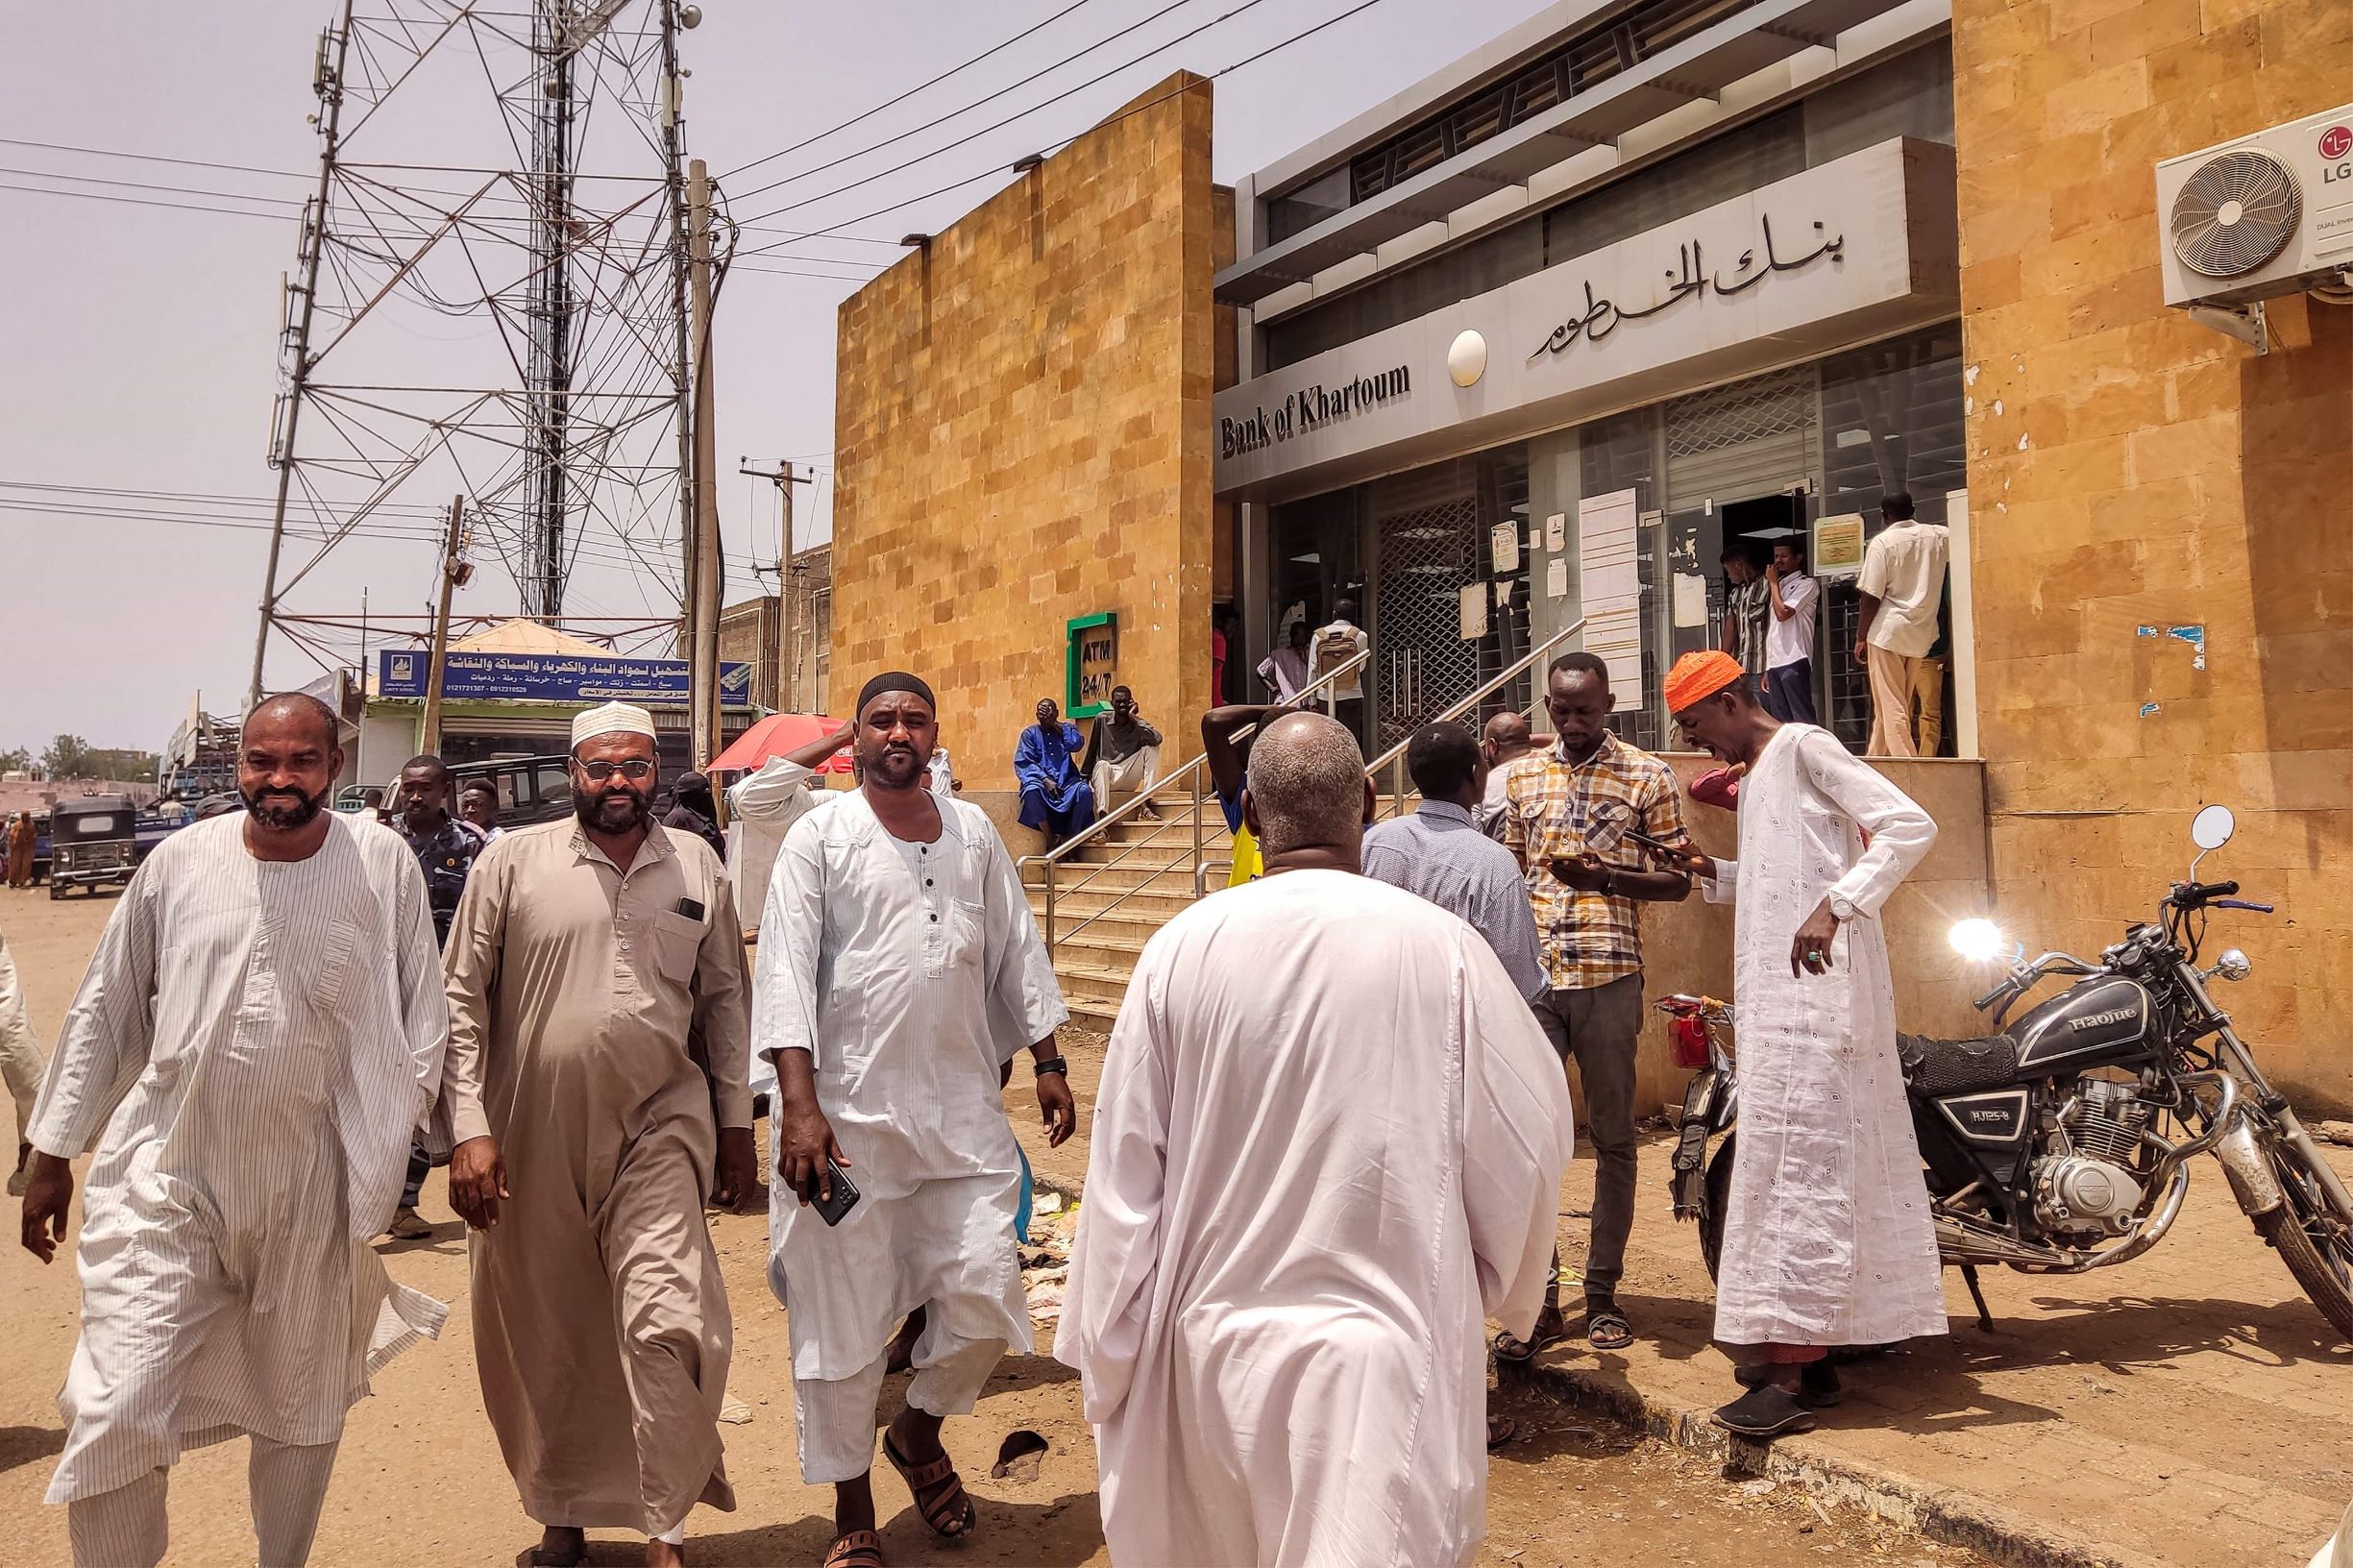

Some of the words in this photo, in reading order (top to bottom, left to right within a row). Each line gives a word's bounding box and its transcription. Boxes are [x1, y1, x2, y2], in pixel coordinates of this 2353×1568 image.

[2323, 162, 2352, 184] LG
[2316, 221, 2336, 231] DUAL
[1714, 212, 1844, 295] بنك
[1525, 238, 1710, 361] الخرطوم
[1220, 405, 1271, 452] Bank
[1274, 394, 1295, 434] of
[1297, 364, 1410, 427] Khartoum
[1083, 640, 1111, 663] ATM
[447, 656, 493, 672] والنقاشة
[495, 657, 539, 673] والسباكة
[541, 660, 587, 675] والكهرباء
[589, 663, 616, 676] البناء
[618, 664, 649, 677] لمواد
[650, 665, 690, 678] لتسهيل
[1082, 673, 1112, 698] 24/7
